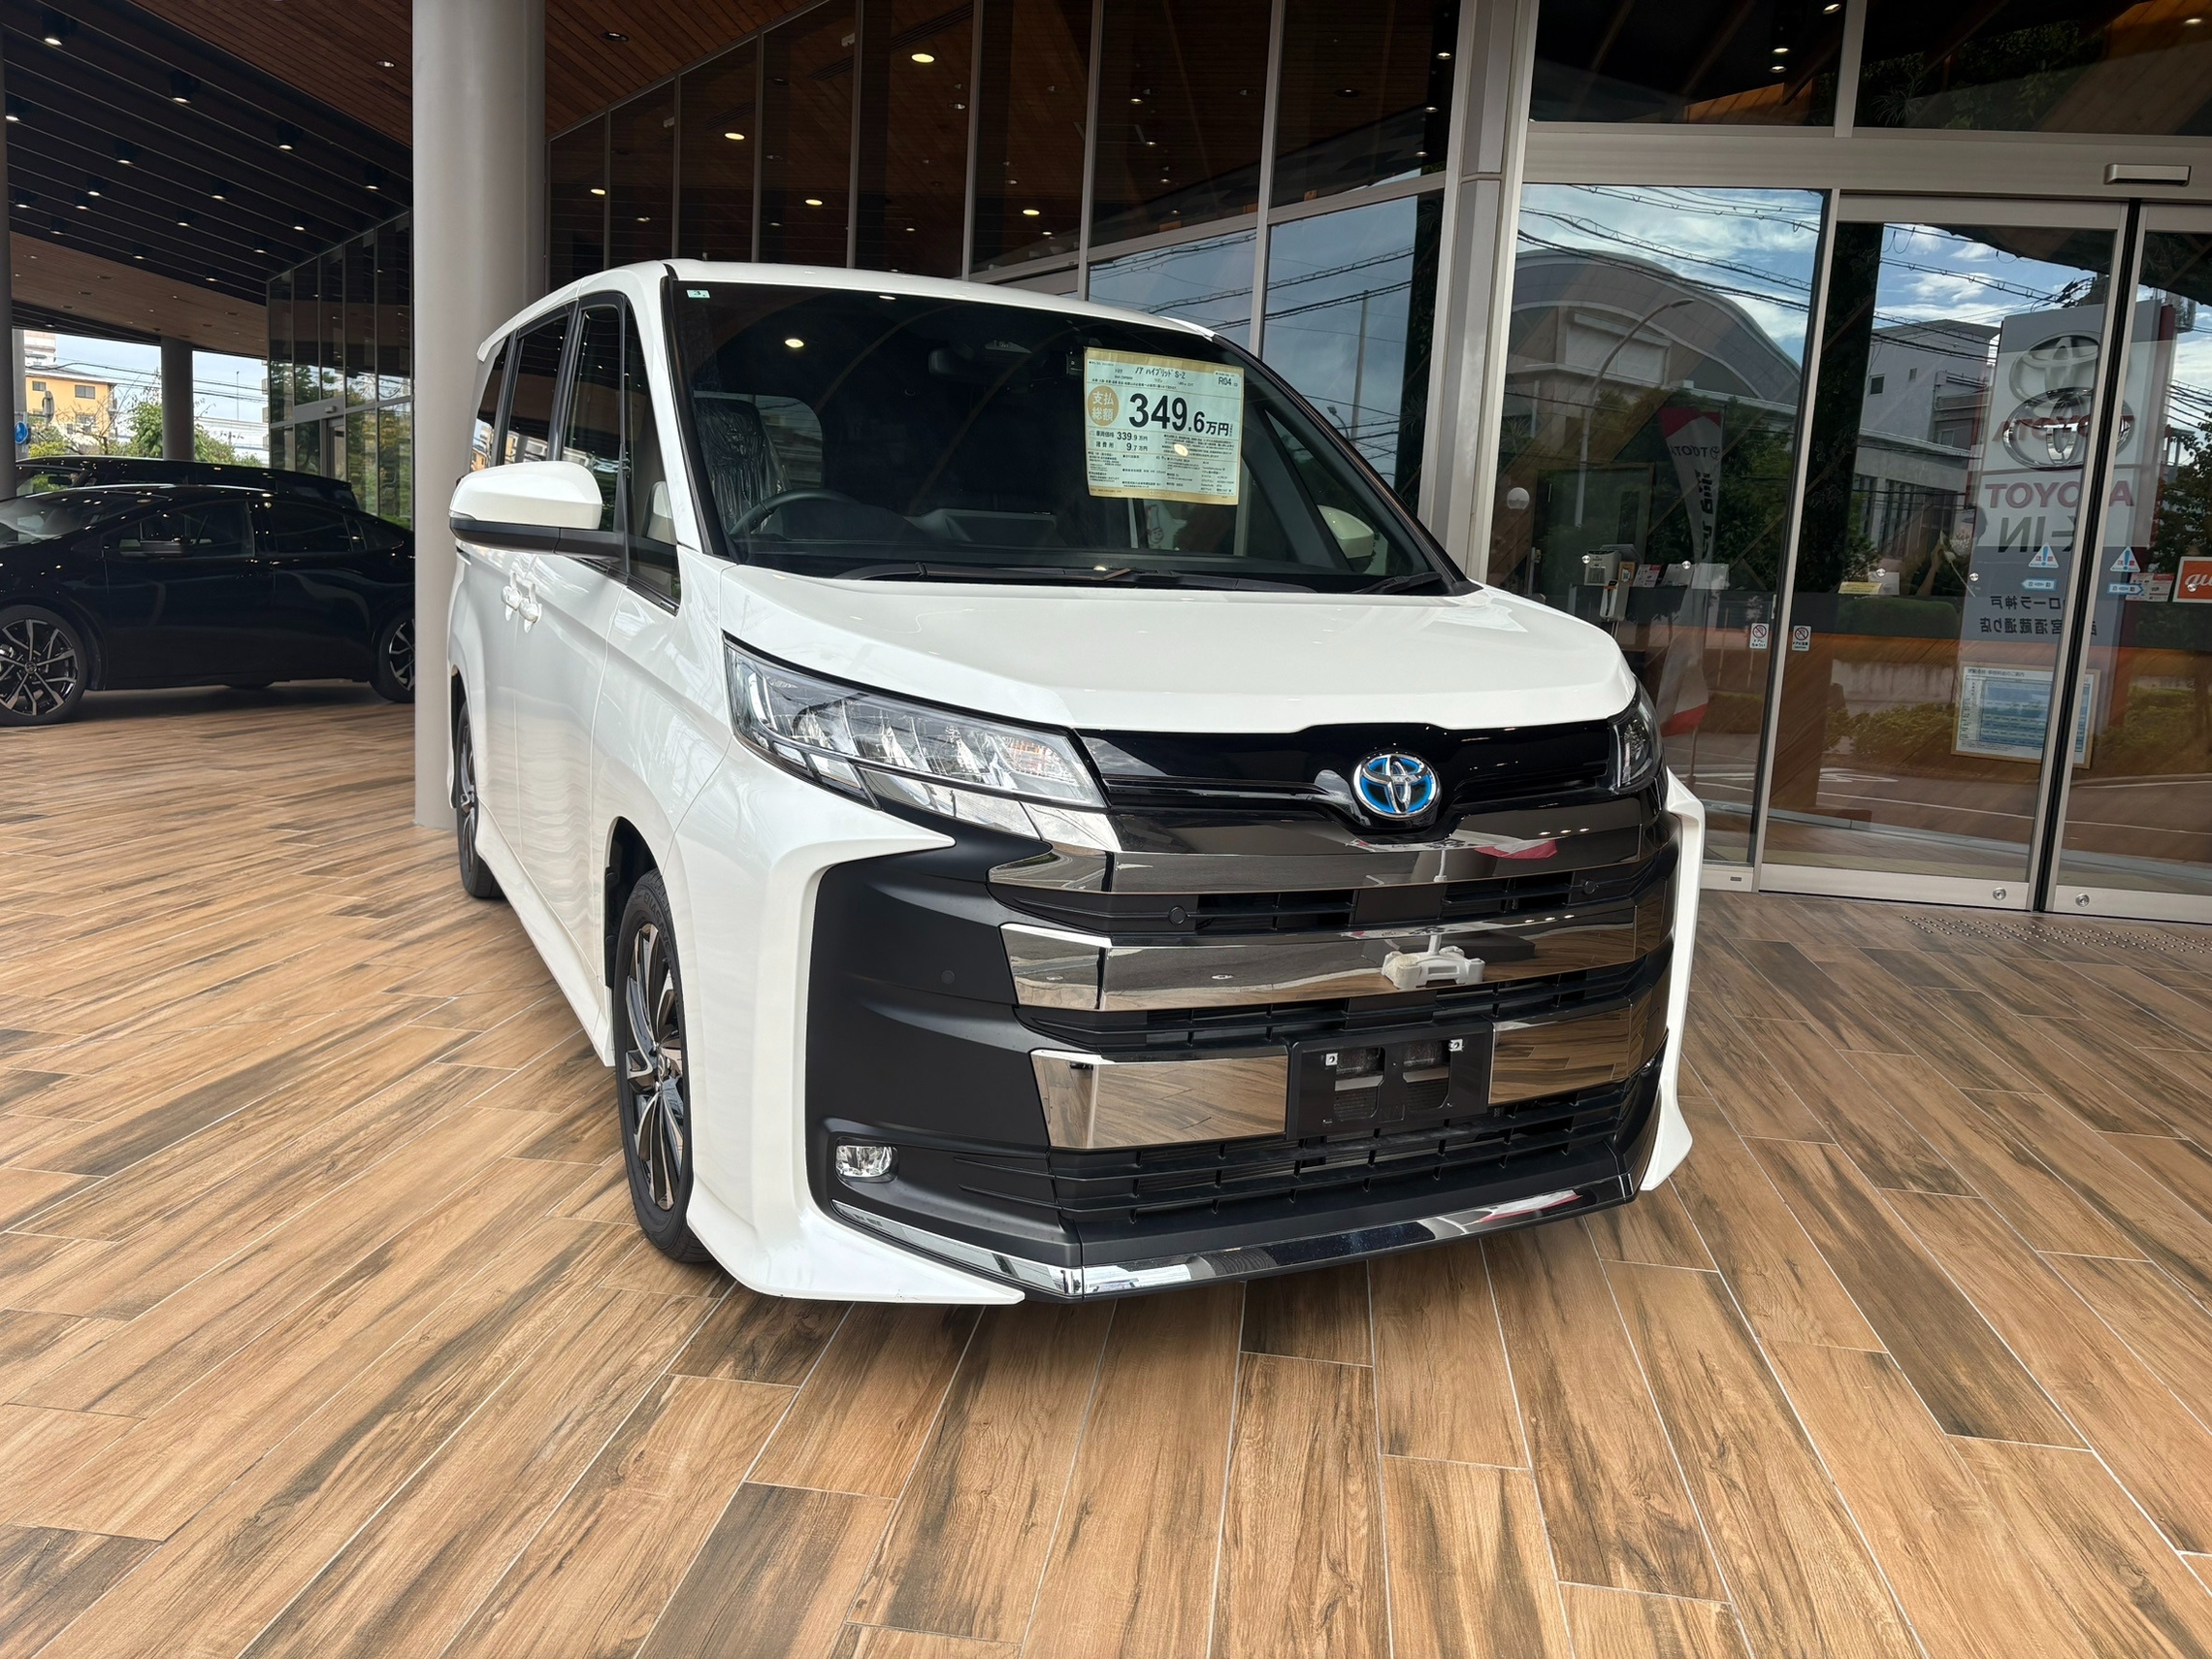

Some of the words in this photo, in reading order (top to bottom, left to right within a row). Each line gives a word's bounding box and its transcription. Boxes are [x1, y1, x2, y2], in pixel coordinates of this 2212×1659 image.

[1175, 371, 1187, 379] S-Z
[1218, 375, 1232, 386] R04
[1092, 391, 1115, 406] 支払
[1091, 407, 1115, 422] 総額
[1985, 479, 2134, 508] TOYOA
